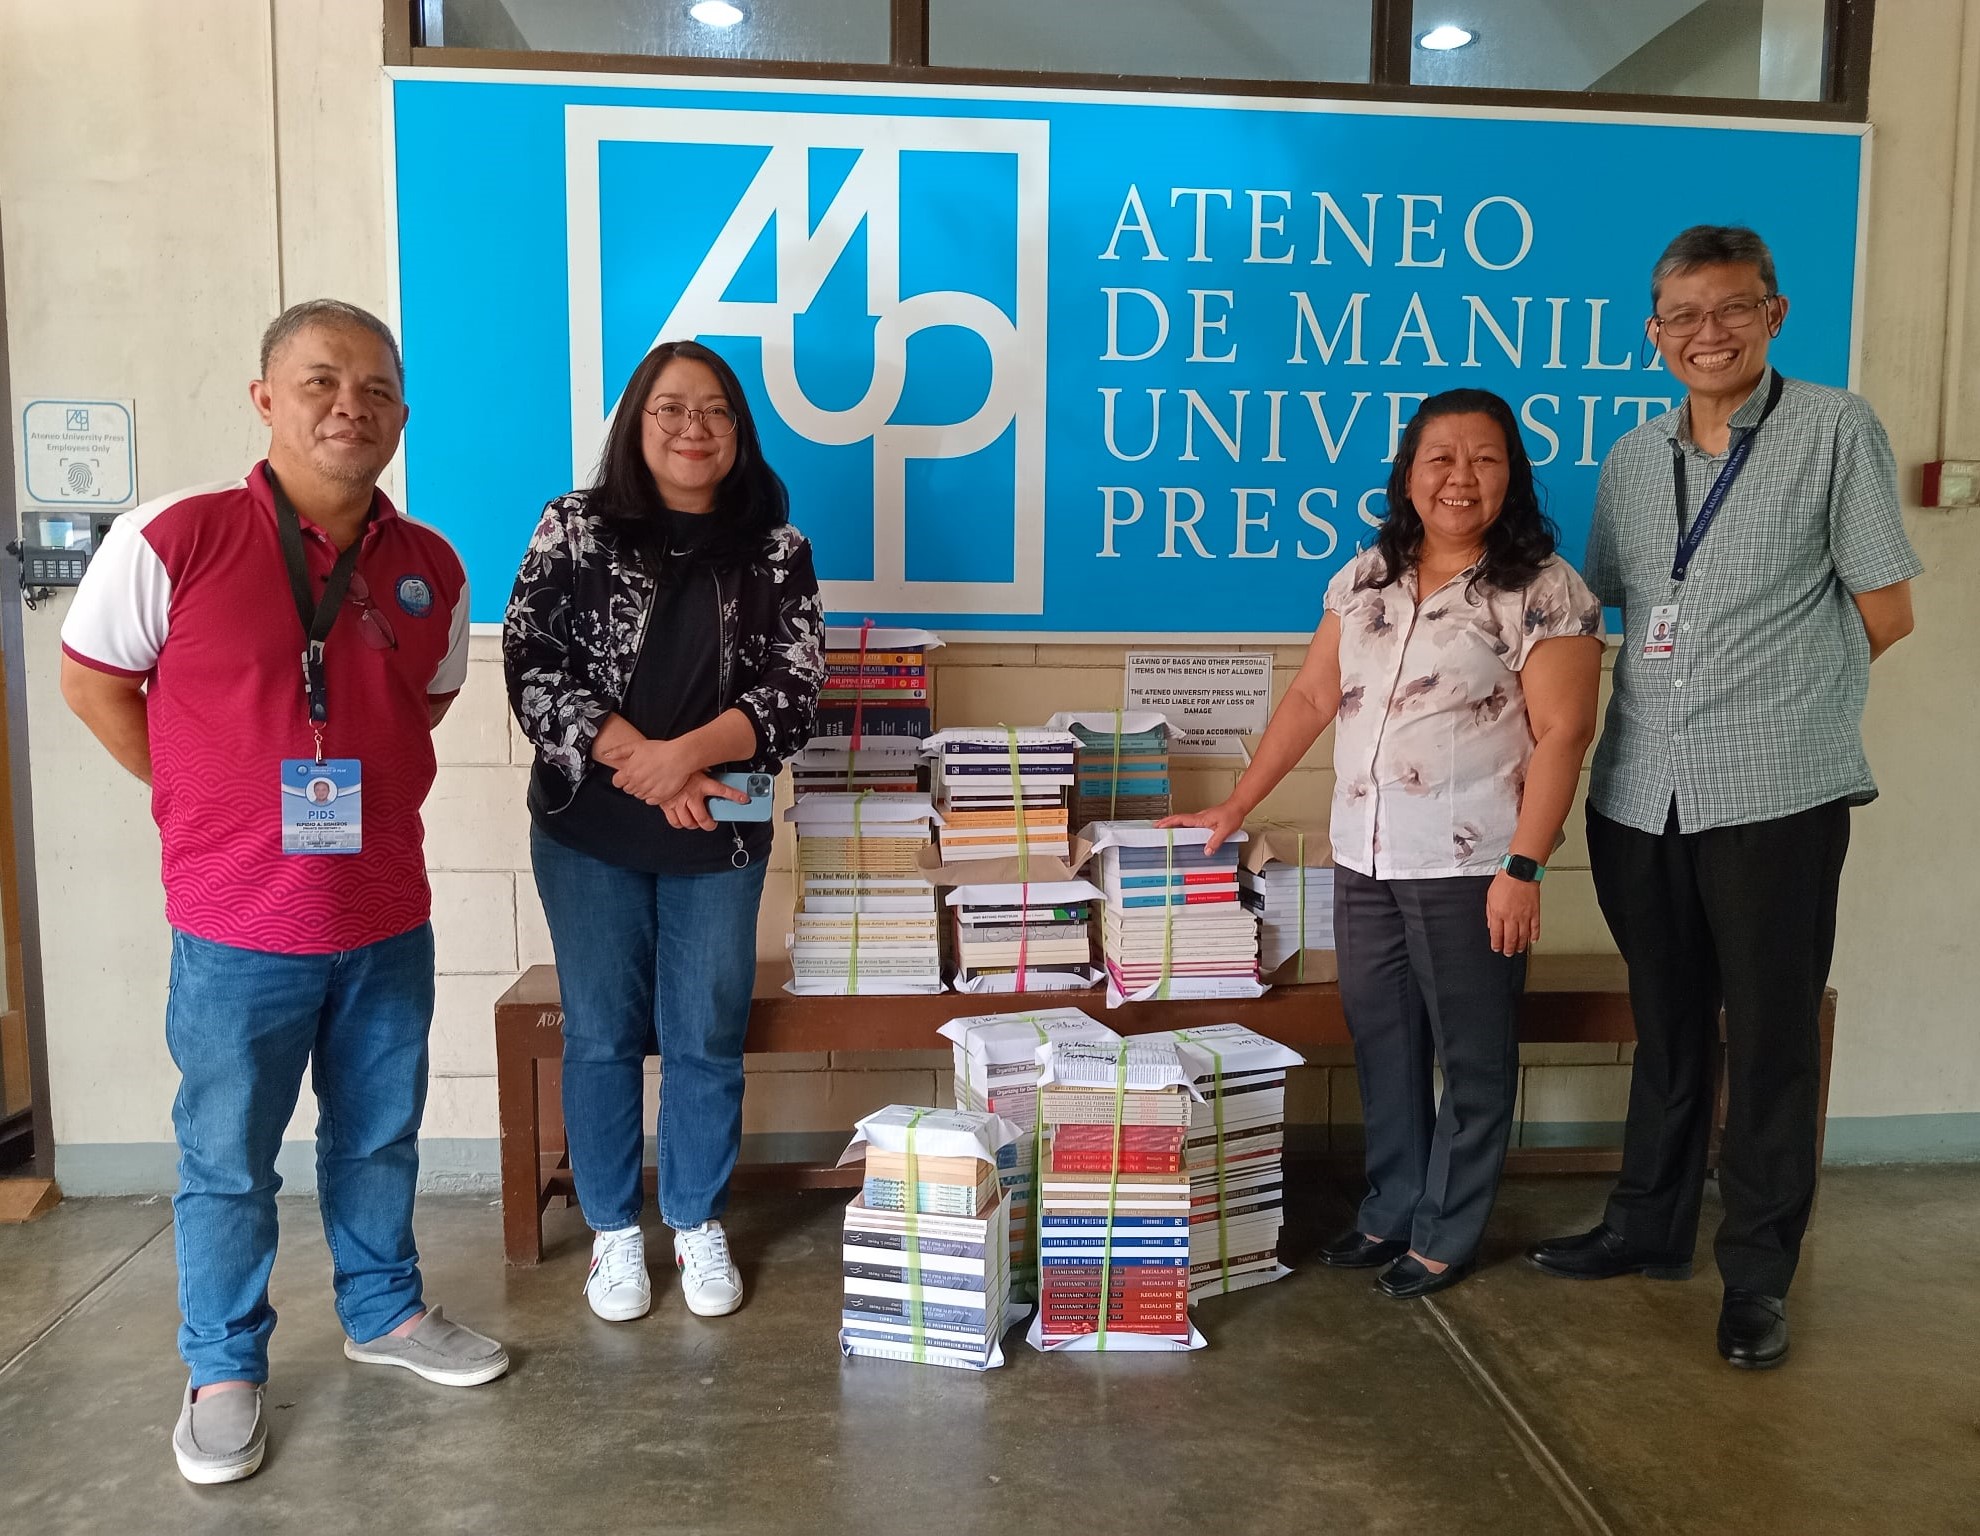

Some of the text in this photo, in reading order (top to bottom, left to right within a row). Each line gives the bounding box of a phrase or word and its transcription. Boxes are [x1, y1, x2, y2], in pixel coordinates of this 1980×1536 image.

[1098, 184, 1534, 270] ATENEO
[1099, 288, 1665, 371] DE MANIL
[31, 432, 60, 440] Ateneo
[62, 433, 102, 442] University
[1098, 388, 1672, 466] UNIVESIT
[47, 444, 110, 453] Employees Only
[1690, 443, 1746, 546] ATENEO DE MANILA UNIVERSITY
[1096, 486, 1386, 560] PRESS
[308, 810, 335, 819] PIDS
[997, 1088, 1018, 1097] Organizing
[1190, 1264, 1210, 1272] ASPORA
